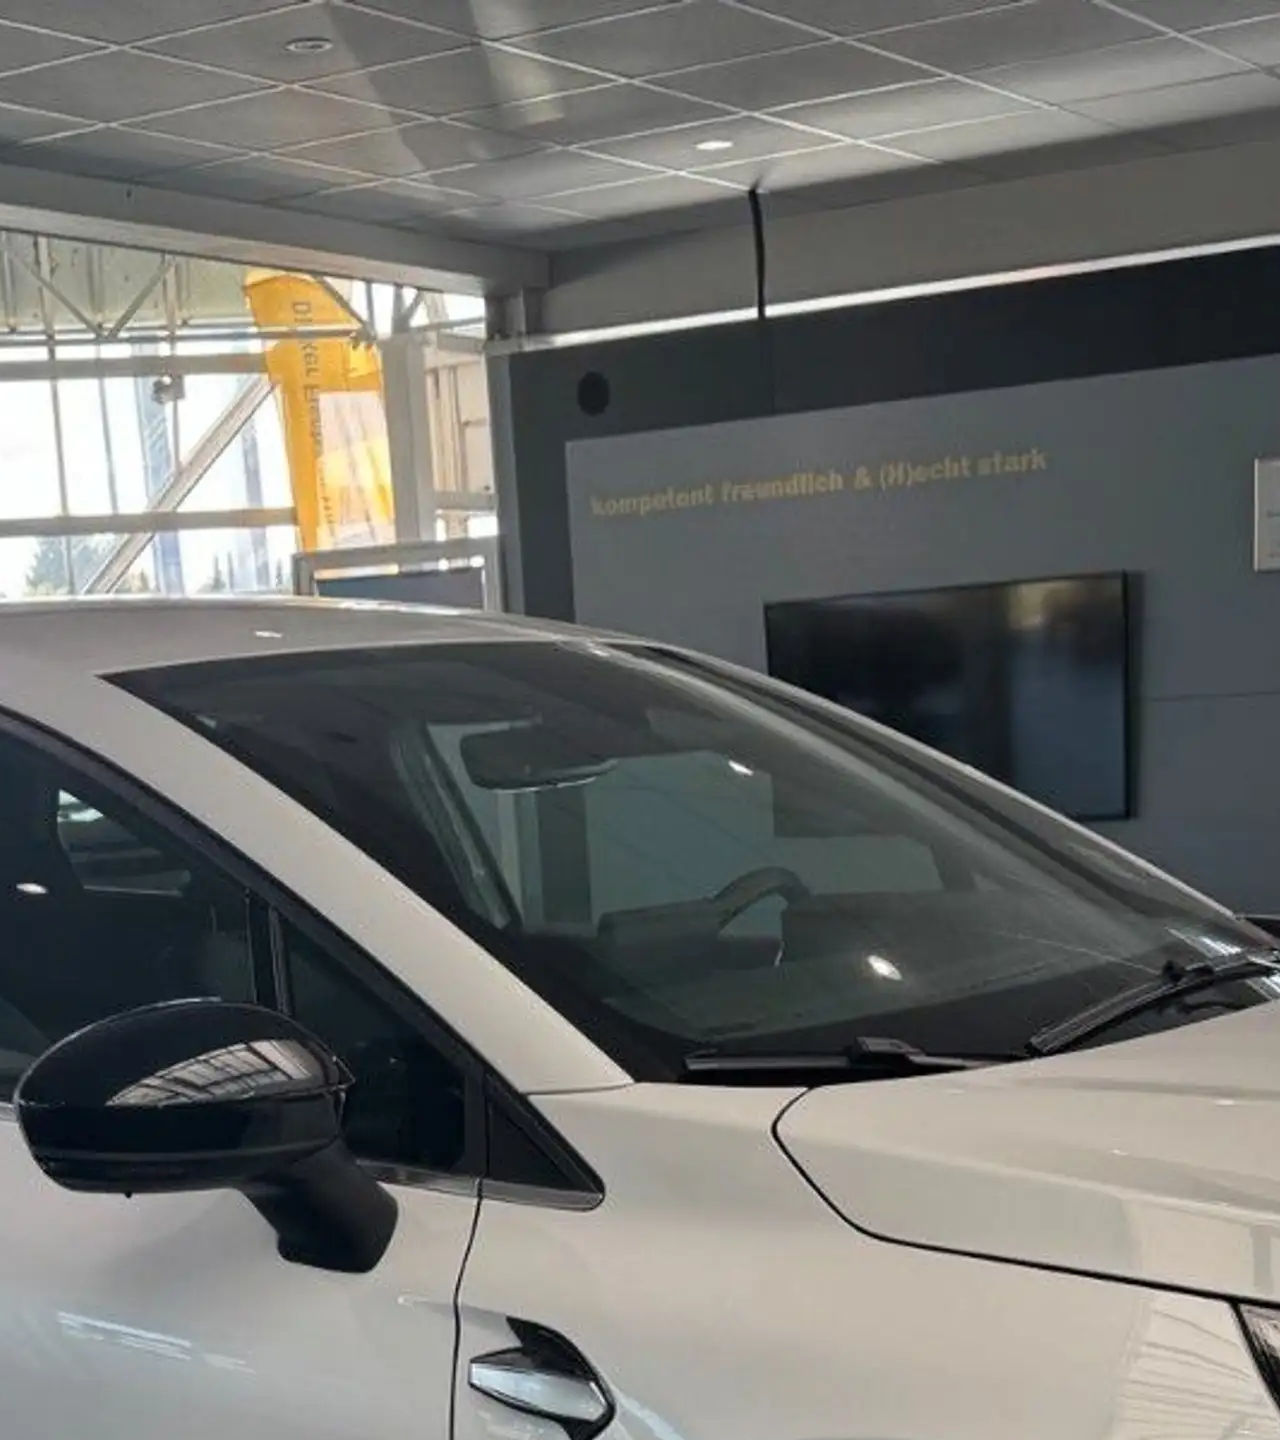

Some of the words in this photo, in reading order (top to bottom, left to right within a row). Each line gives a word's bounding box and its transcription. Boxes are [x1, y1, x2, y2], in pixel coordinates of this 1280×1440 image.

[589, 482, 714, 516] kompetent
[722, 469, 844, 502] freundlich
[854, 465, 872, 490] &
[977, 447, 1047, 475] stark
